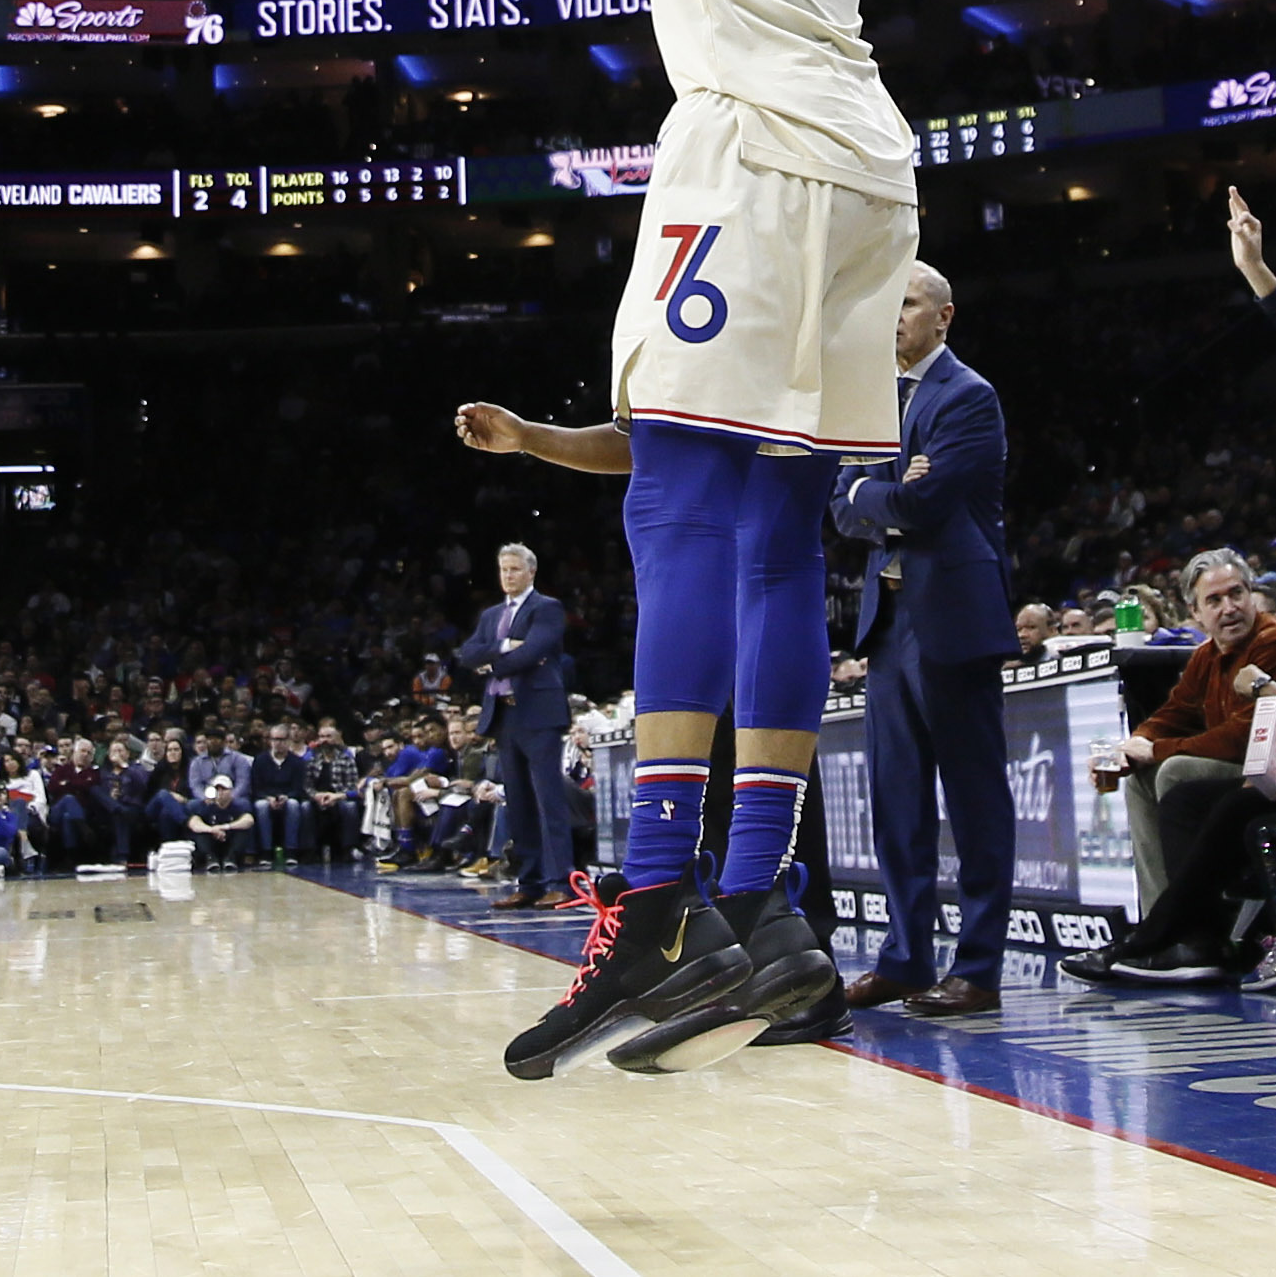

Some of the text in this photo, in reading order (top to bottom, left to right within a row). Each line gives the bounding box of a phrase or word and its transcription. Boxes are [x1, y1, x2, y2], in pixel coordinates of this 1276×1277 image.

[53, 1, 144, 32] Sports
[185, 14, 223, 45] 76
[930, 132, 950, 147] 22
[188, 172, 253, 188] FLS TOL
[273, 166, 452, 187] PLAYER 16 0 13 2 10
[68, 184, 162, 205] CAVALIERS
[193, 189, 247, 211] 2 4
[273, 185, 449, 206] POINTS 0 5 6 2 2
[654, 224, 728, 343] 76
[1051, 913, 1114, 950] GEICO
